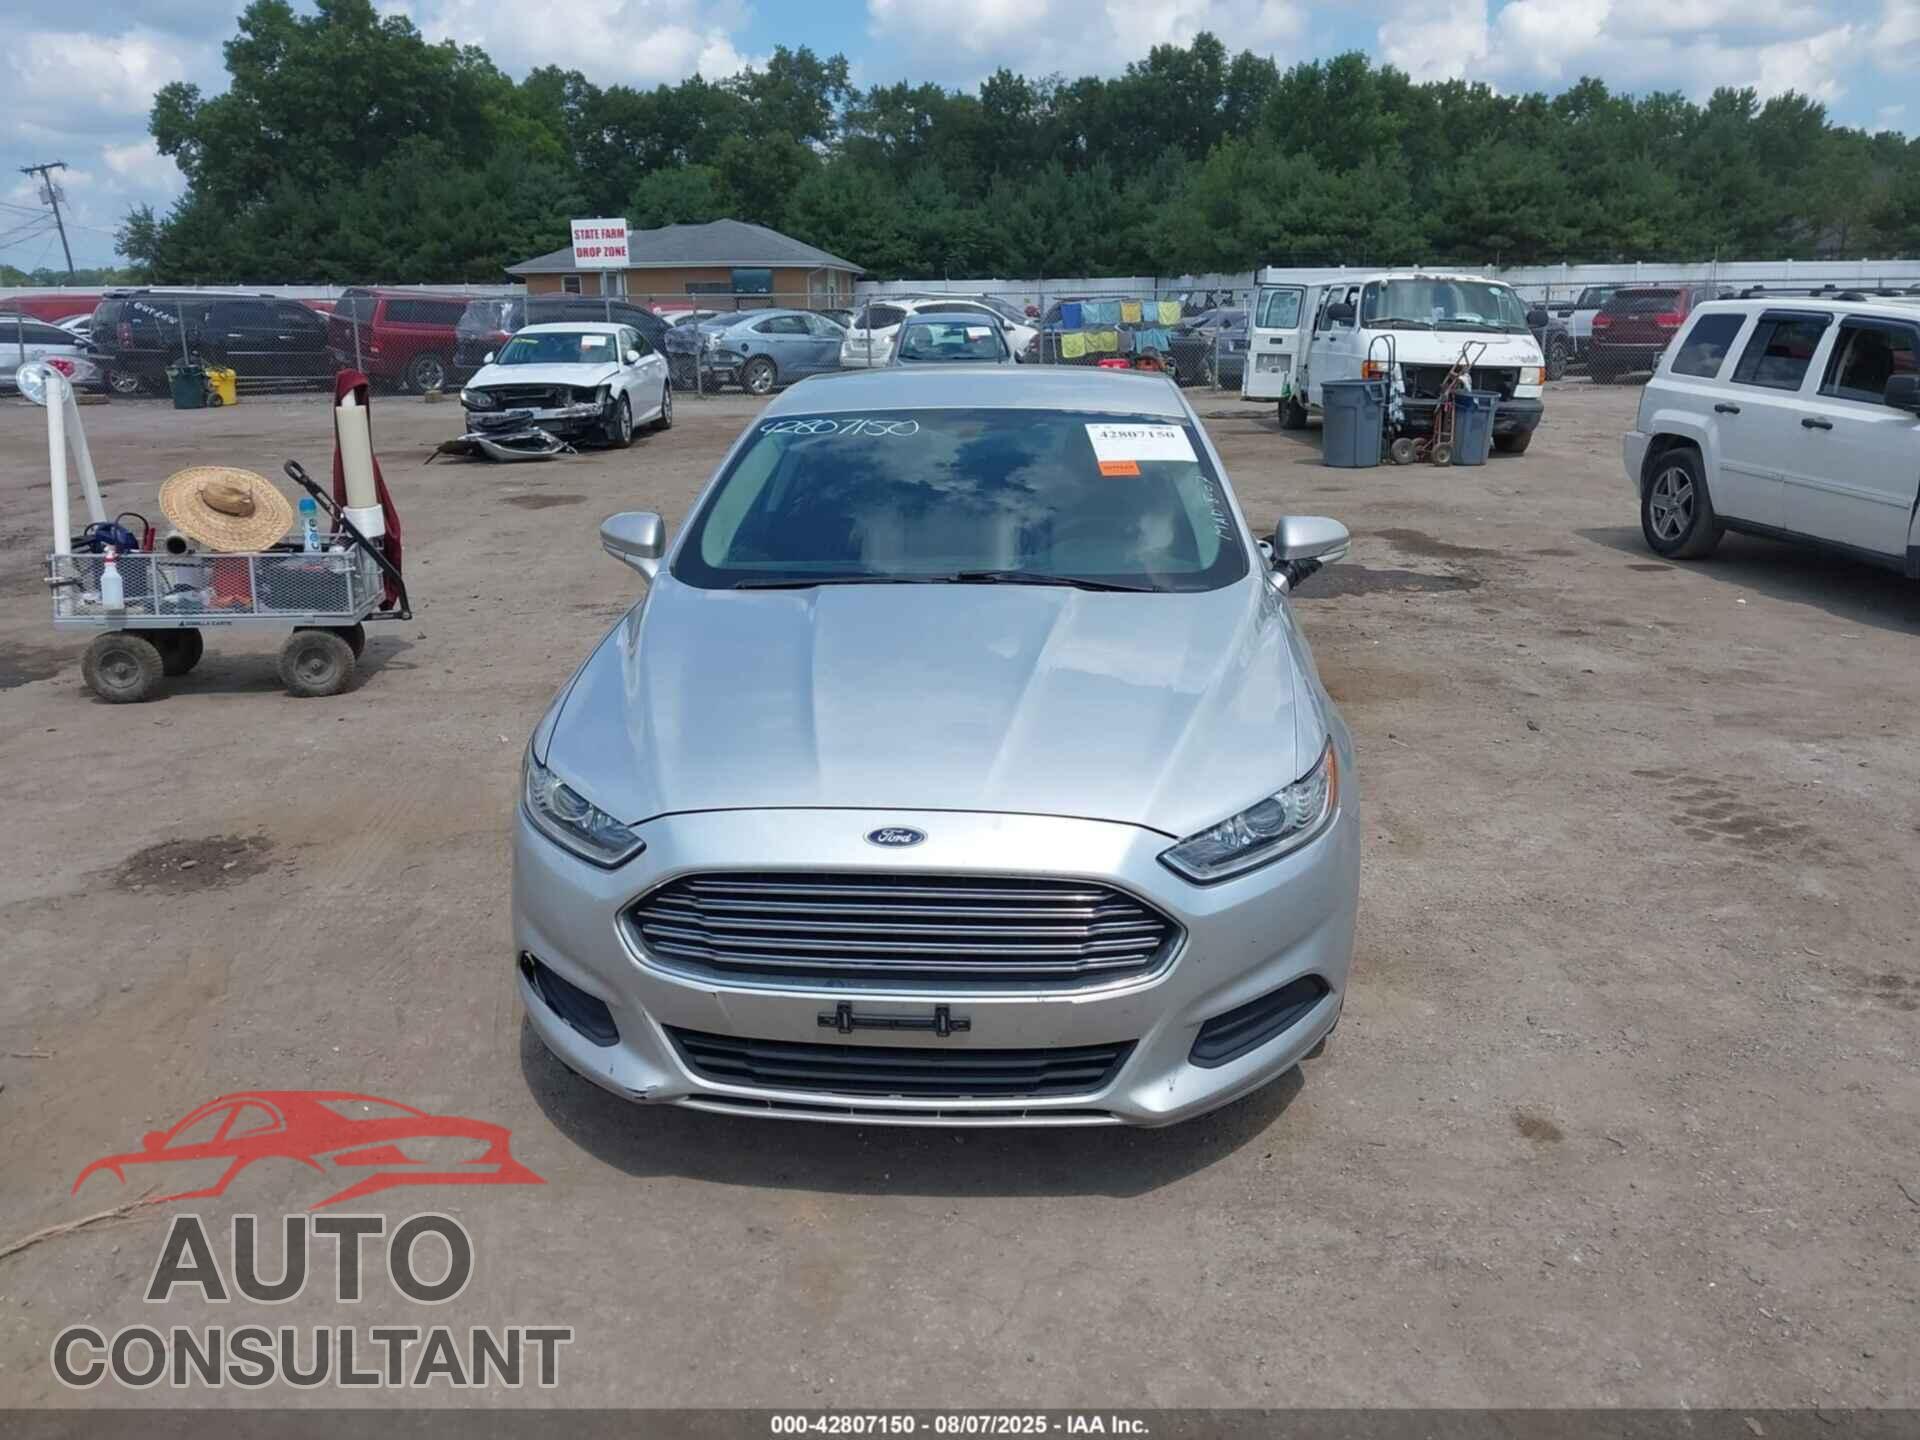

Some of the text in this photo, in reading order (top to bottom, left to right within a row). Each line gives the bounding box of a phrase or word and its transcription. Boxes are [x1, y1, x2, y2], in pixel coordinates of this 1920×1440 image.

[574, 228, 625, 240] STATE FARM
[576, 246, 627, 258] DROP ZONE
[759, 419, 919, 437] 42807150
[1100, 430, 1176, 439] 42807150
[878, 829, 912, 842] Ford
